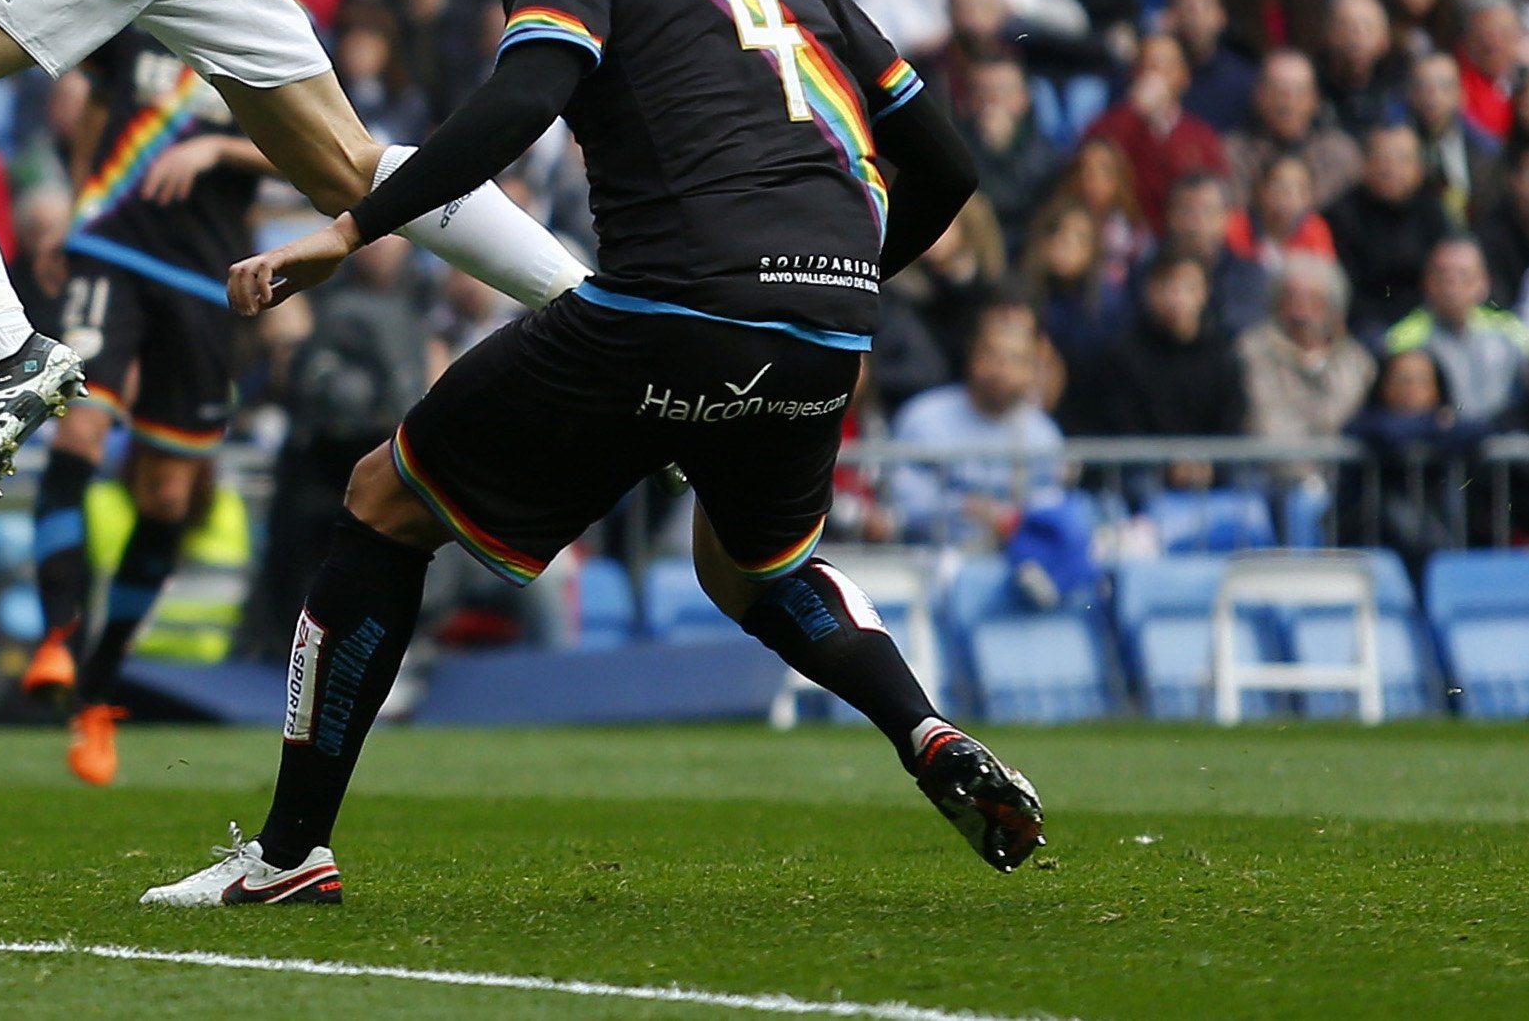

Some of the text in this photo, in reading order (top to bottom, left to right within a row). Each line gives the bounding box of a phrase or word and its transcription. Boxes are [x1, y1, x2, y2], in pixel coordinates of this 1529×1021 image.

[759, 255, 880, 280] SOLIDARIDA
[759, 271, 793, 283] RAYO
[793, 272, 853, 288] VALLECANO
[766, 392, 849, 421] viajes.com
[286, 650, 305, 736] SPORTS
